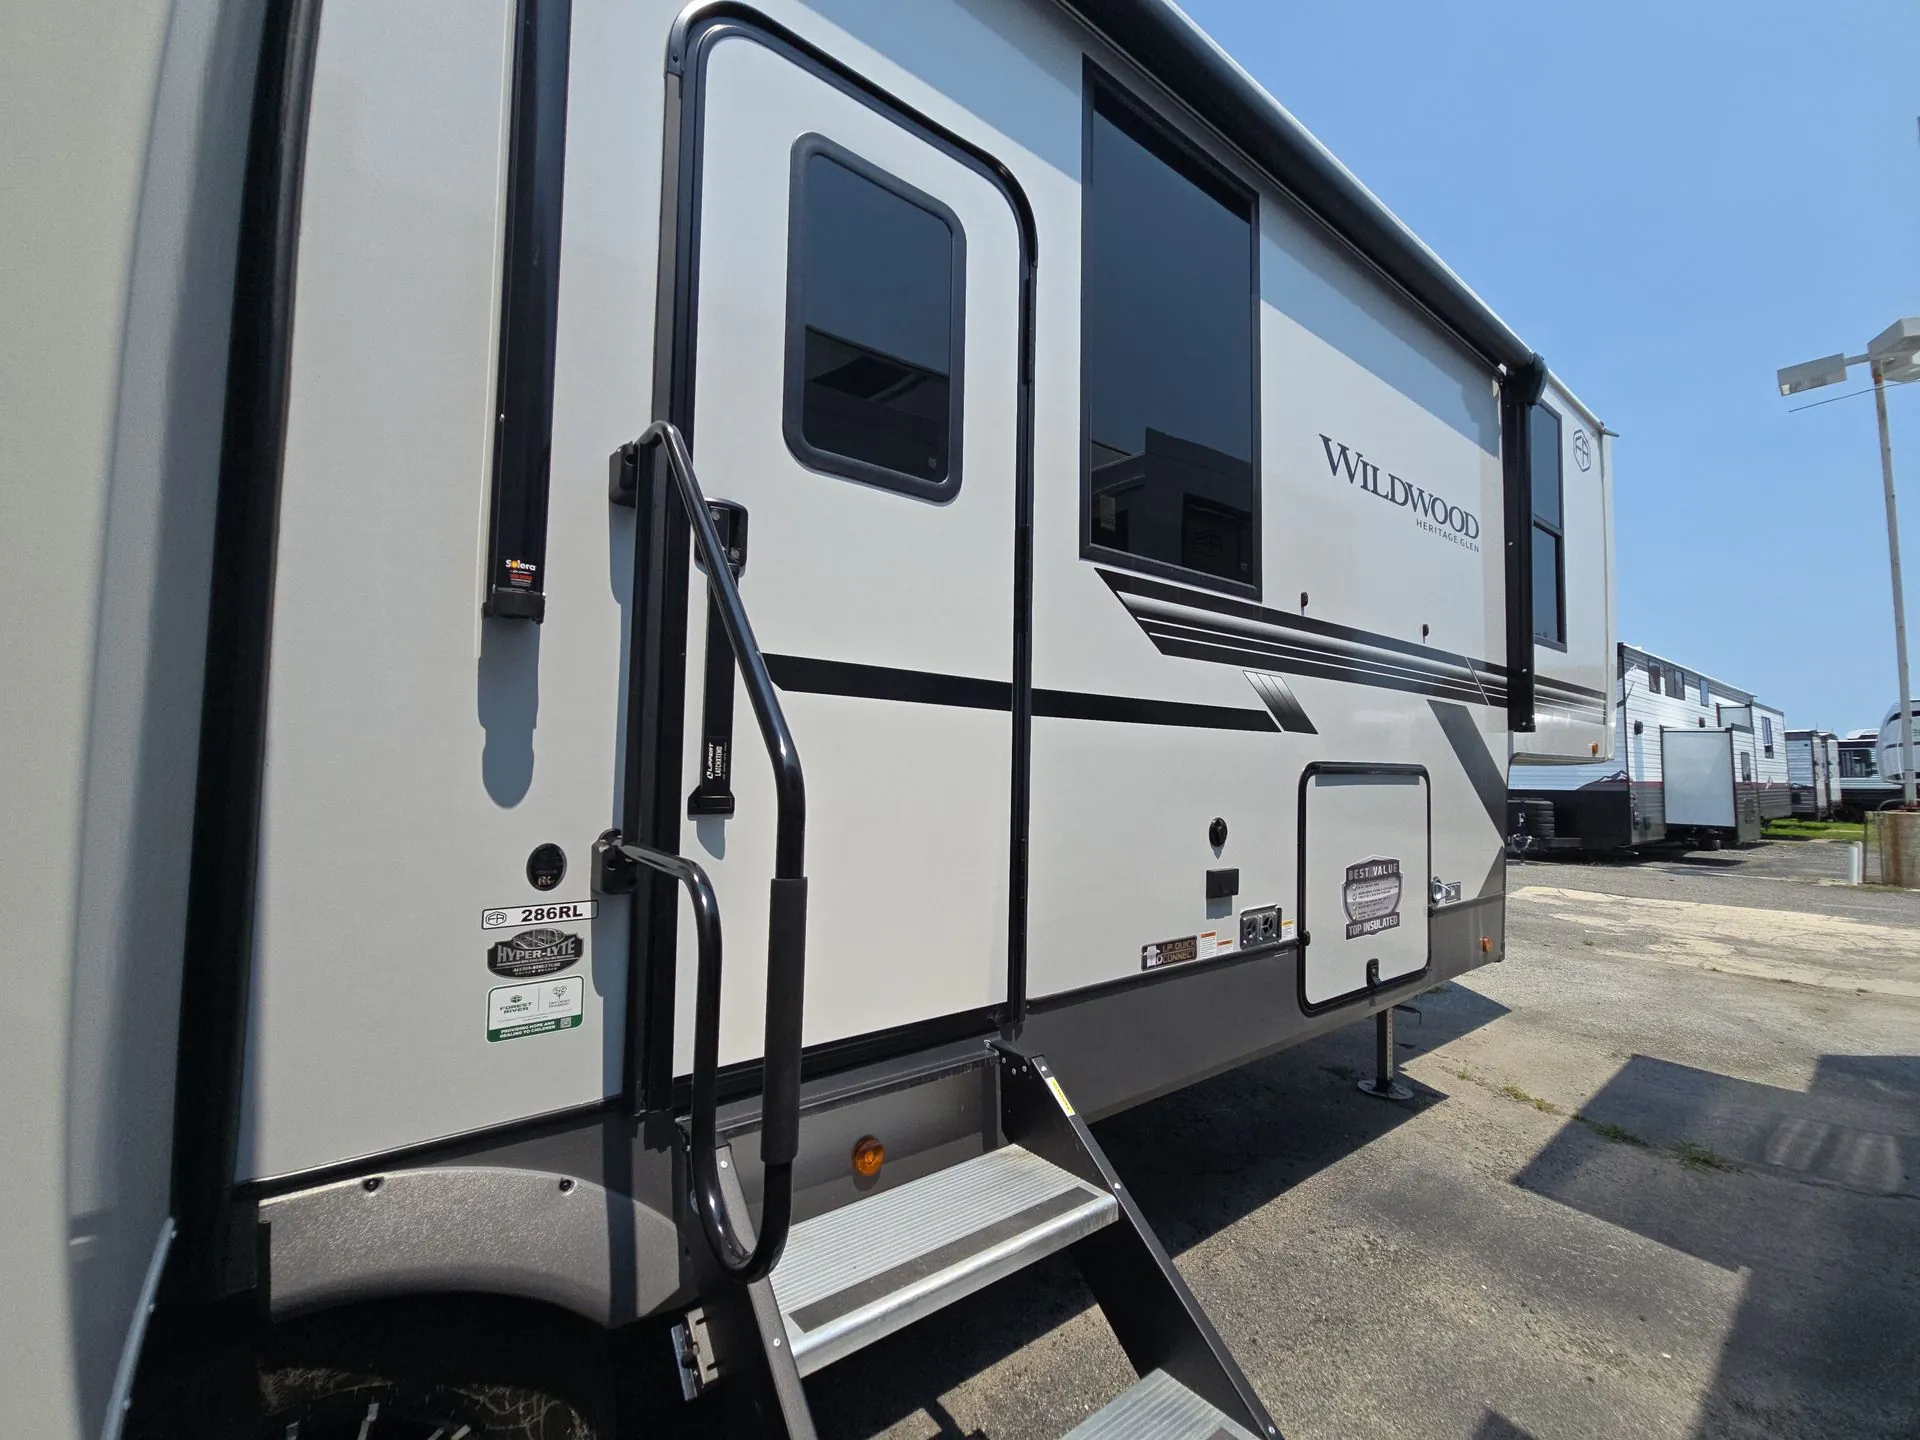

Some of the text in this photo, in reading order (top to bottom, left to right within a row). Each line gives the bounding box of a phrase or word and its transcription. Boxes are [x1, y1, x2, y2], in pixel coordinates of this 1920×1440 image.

[1318, 433, 1480, 539] WILDWOOD
[1416, 518, 1479, 553] HERITAGE GLEN
[505, 559, 536, 571] Solera
[1348, 863, 1398, 880] BEST VALUE
[521, 905, 583, 922] 286RL
[1348, 915, 1398, 937] TOP INSULATED
[497, 937, 576, 963] HYPER-LYTE
[1162, 943, 1173, 953] LP
[1174, 939, 1196, 950] QUICK
[1162, 950, 1195, 963] CONNECT
[499, 1002, 533, 1011] FOREST
[499, 1030, 522, 1038] HEALING
[531, 1025, 556, 1033] CHILDREN
[501, 1025, 529, 1034] PROVIDING
